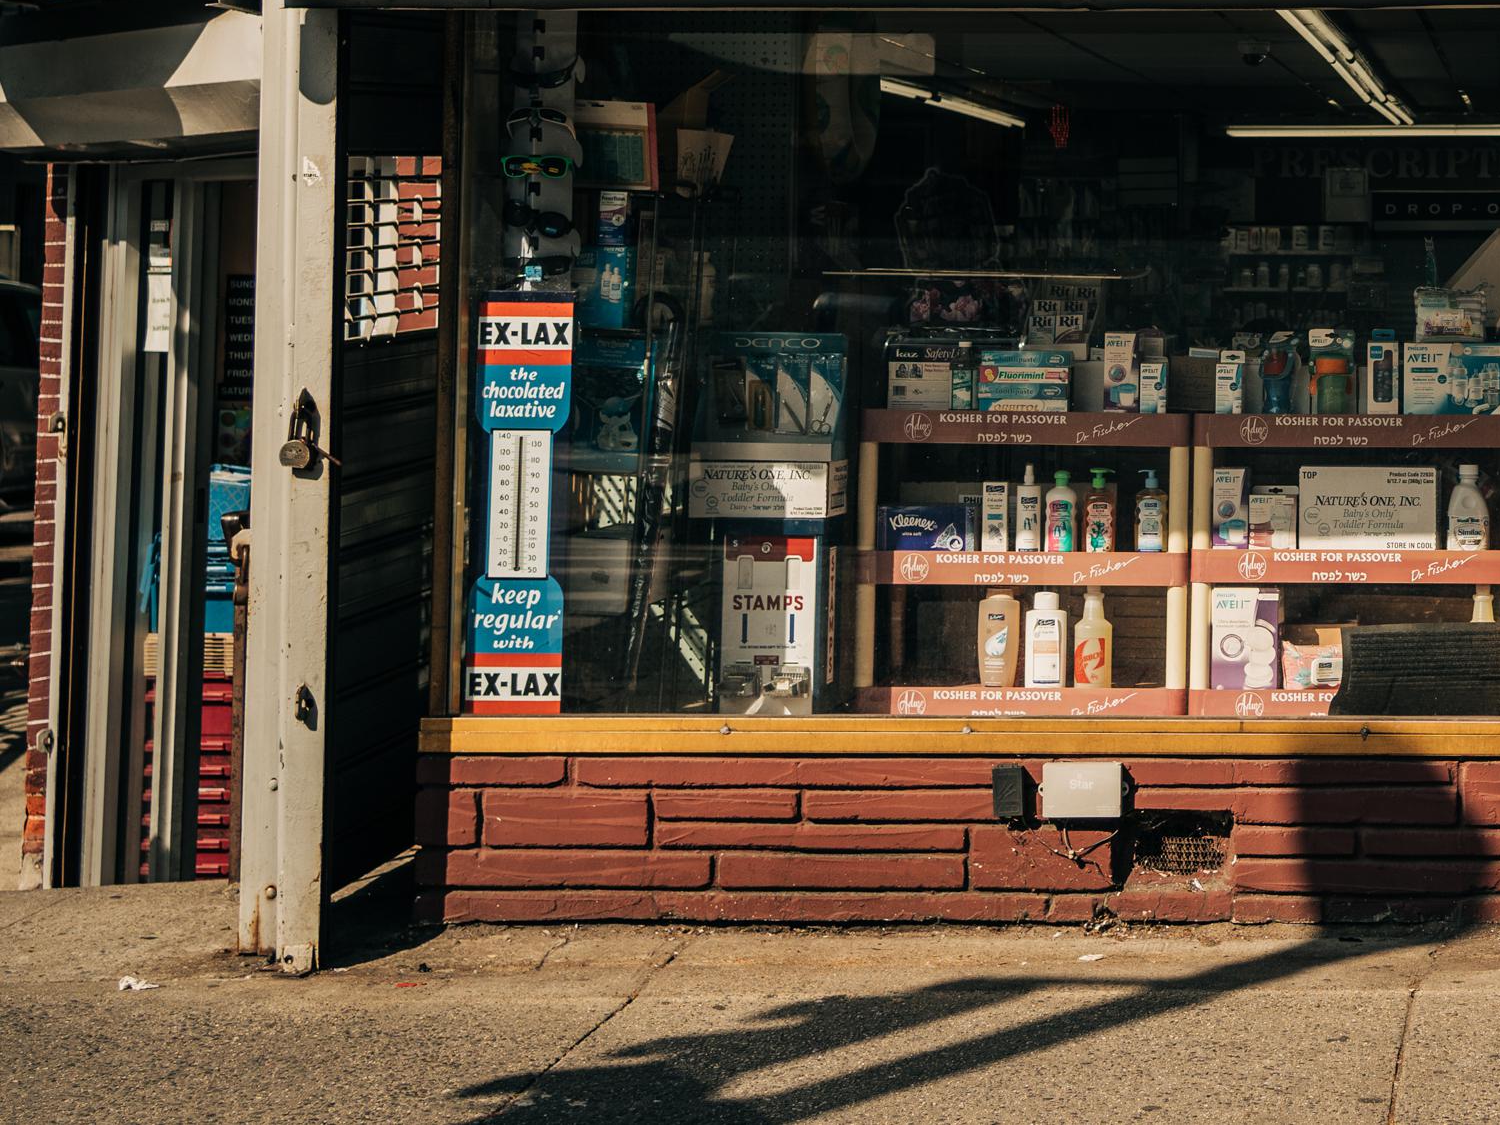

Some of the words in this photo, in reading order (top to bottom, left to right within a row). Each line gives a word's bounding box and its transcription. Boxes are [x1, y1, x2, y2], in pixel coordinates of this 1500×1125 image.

[1051, 285, 1070, 298] Rit
[1077, 286, 1096, 299] Rit
[1037, 301, 1057, 312] Rit
[1064, 301, 1083, 312] Rit
[1033, 316, 1052, 327] Rit
[1060, 316, 1080, 327] Rit
[480, 322, 569, 346] EX-LAX
[509, 367, 538, 381] the
[998, 371, 1045, 380] Fluorimint
[482, 382, 565, 399] chocolated
[489, 401, 556, 418] laxative
[940, 414, 983, 424] KOSHER
[987, 414, 1008, 424] FOR
[1012, 415, 1067, 425] PASSOVER
[1275, 416, 1319, 426] KOSHER
[1323, 417, 1344, 426] FOR
[1348, 417, 1403, 427] PASSOVER
[977, 432, 1008, 443] לפסח
[1011, 433, 1032, 443] כשר
[1313, 435, 1343, 446] לפסח
[1346, 436, 1368, 445] כשר
[704, 466, 757, 480] NATURE'S
[1302, 471, 1317, 479] TOP
[732, 482, 759, 493] Baby's
[721, 493, 754, 502] Toddler
[1315, 492, 1368, 507] NATURE'S
[1369, 496, 1396, 507] ONE,
[1400, 496, 1421, 507] INC.
[1343, 509, 1370, 518] Baby's
[1371, 509, 1394, 518] Only
[889, 513, 934, 531] Kleenex
[1333, 519, 1366, 528] Toddler
[1368, 519, 1404, 528] Formula
[1458, 528, 1482, 536] Similac
[936, 553, 980, 564] KOSHER
[983, 554, 1005, 564] FOR
[1009, 554, 1064, 565] PASSOVER
[1274, 552, 1318, 562] KOSHER
[1321, 552, 1343, 562] FOR
[1347, 552, 1402, 562] PASSOVER
[974, 572, 1004, 583] לפסח
[1007, 574, 1029, 583] כשר
[1312, 571, 1343, 581] לפסח
[1345, 572, 1367, 581] כשר
[490, 582, 541, 607] keep
[733, 595, 803, 611] STAMPS
[492, 633, 535, 649] with
[469, 671, 559, 697] EX-LAX
[933, 690, 977, 700] KOSHER
[980, 691, 1002, 701] FOR
[1006, 691, 1061, 701] PASSOVER
[1271, 692, 1315, 702] KOSHER
